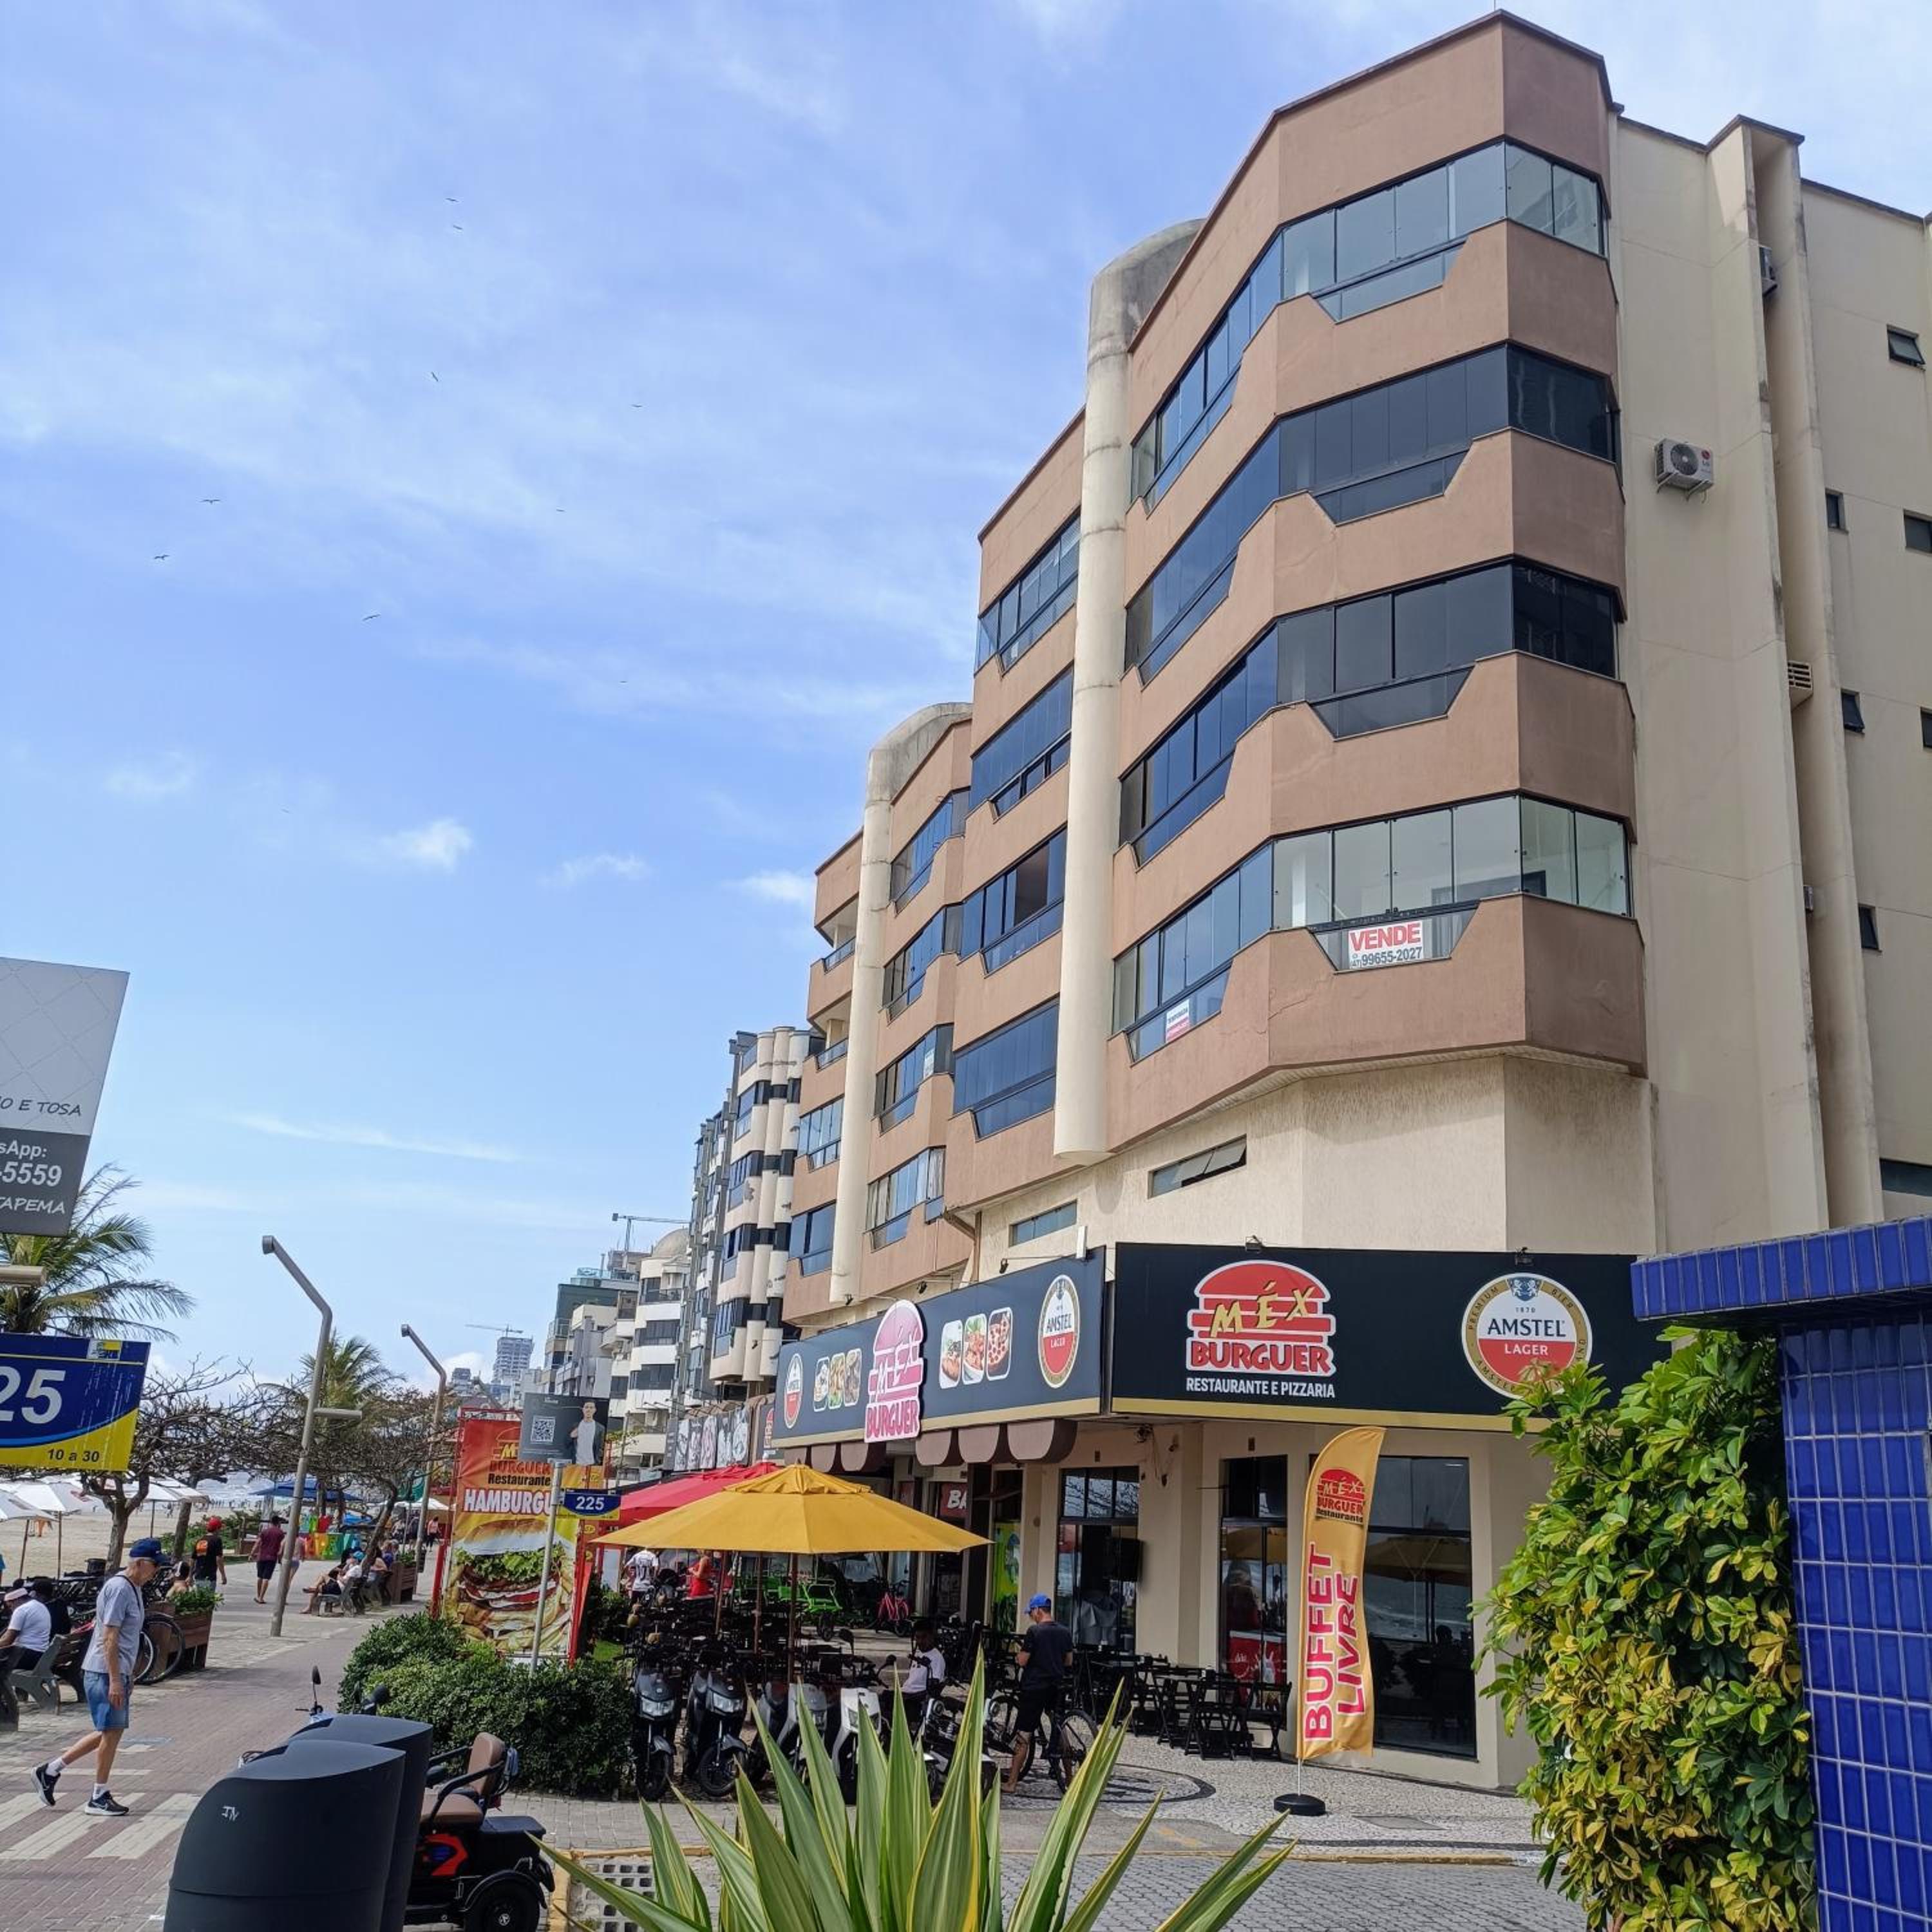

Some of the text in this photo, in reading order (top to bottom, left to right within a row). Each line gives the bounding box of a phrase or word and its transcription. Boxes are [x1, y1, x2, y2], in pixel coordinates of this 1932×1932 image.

[1350, 922, 1421, 951] VENDE
[1361, 946, 1423, 967] 99655-2027
[19, 1099, 33, 1111] E
[37, 1101, 82, 1117] TOSA
[1210, 1280, 1316, 1338] MÉX
[1468, 1286, 1575, 1330] PREMIUM BIER
[1046, 1313, 1072, 1334] AMSTEL
[1487, 1318, 1566, 1338] AMSTEL
[1191, 1340, 1331, 1374] BURGUER
[1504, 1343, 1549, 1356] LAGER
[1186, 1378, 1336, 1398] RESTAURANTE E PIZZARIA
[866, 1399, 918, 1439] BURGUER
[48, 1448, 100, 1463] 10 a 30
[488, 1473, 551, 1486] Restaurante
[575, 1496, 605, 1510] 225
[1317, 1496, 1363, 1515] BURGUER
[1305, 1542, 1333, 1740] BUFFET
[1335, 1571, 1365, 1714] LIVRE
